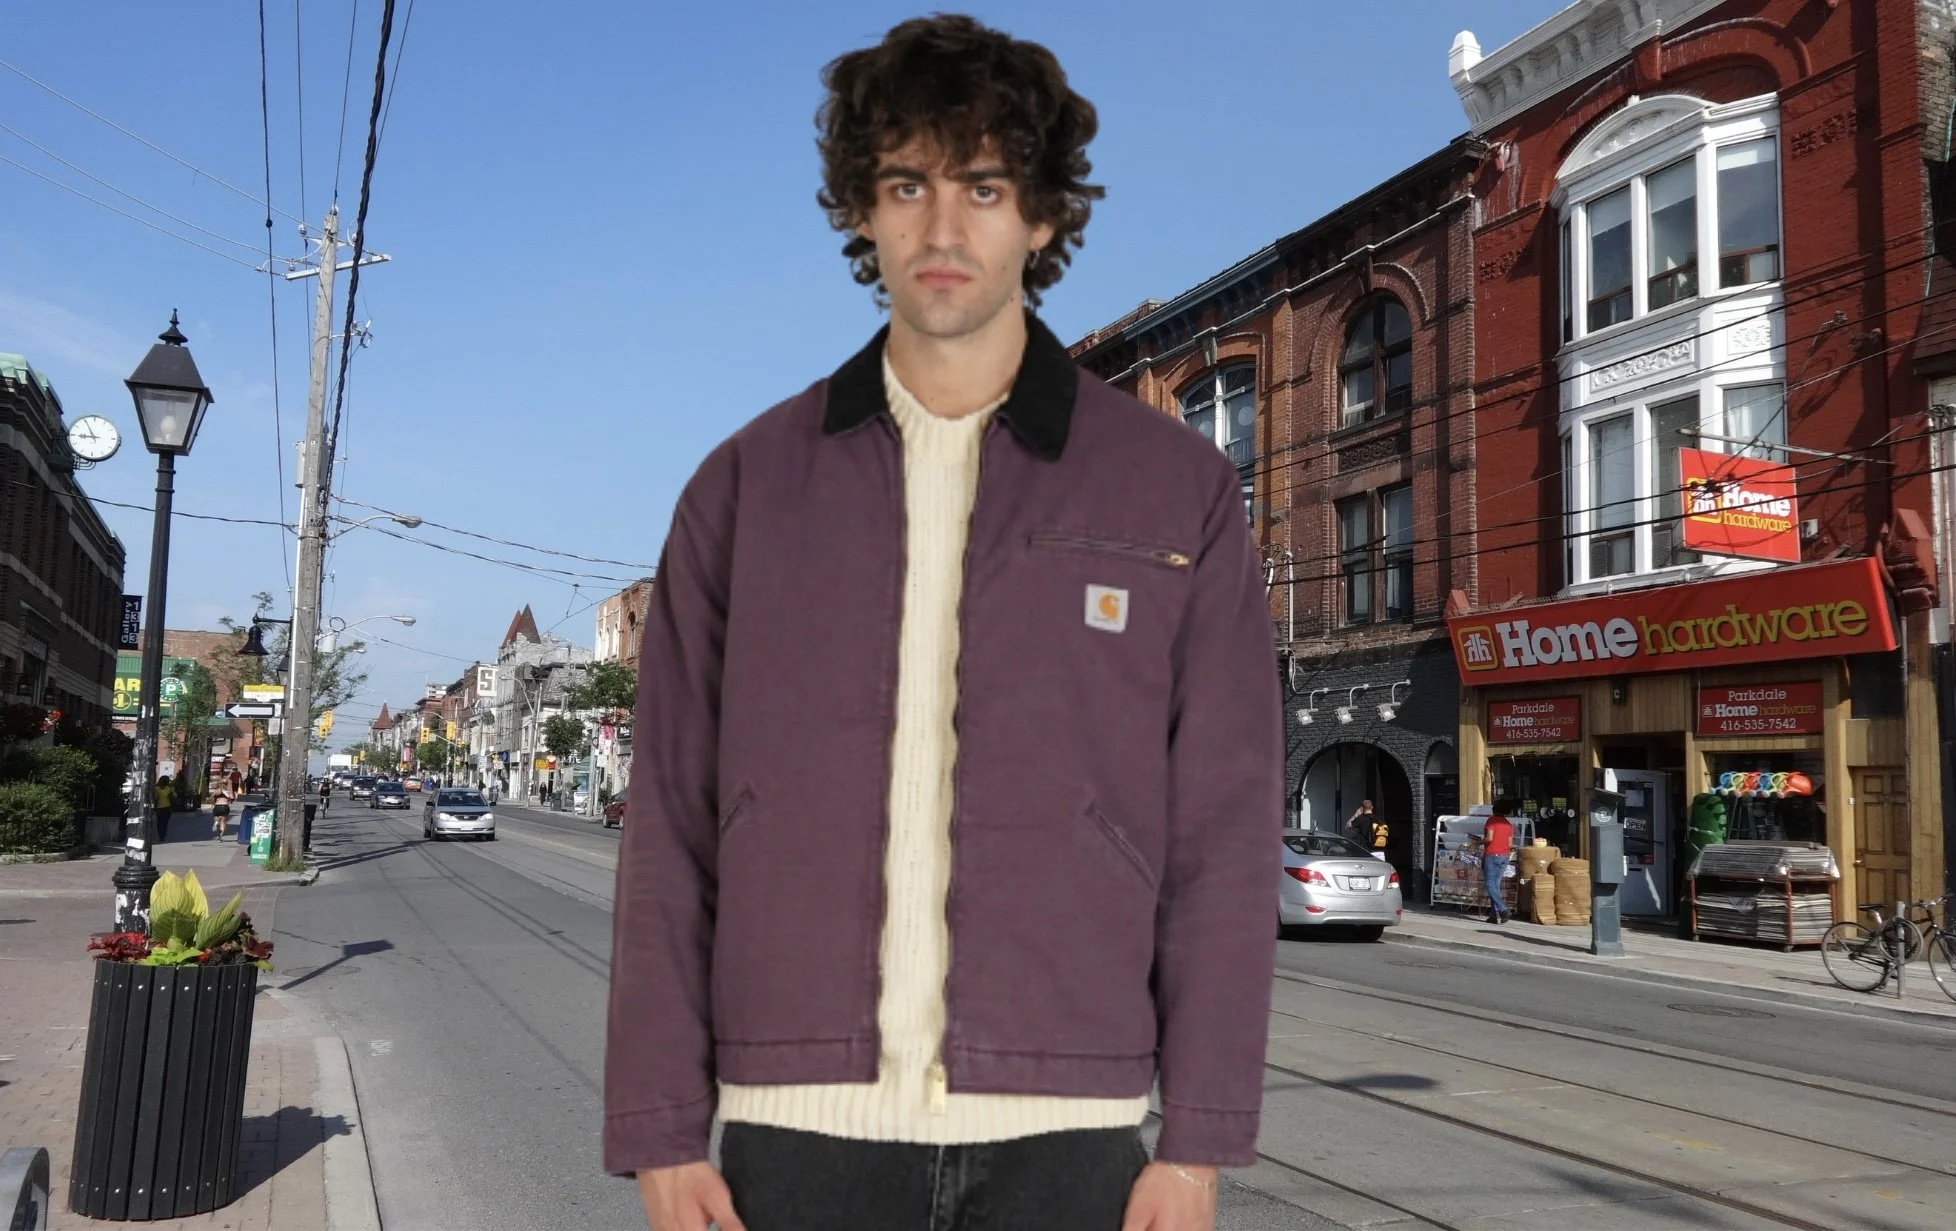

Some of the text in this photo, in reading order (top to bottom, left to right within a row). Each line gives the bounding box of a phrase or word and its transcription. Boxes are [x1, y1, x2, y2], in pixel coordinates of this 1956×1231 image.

[1722, 482, 1791, 517] Home
[1723, 511, 1792, 533] hardware
[121, 601, 132, 643] Gallery
[1495, 600, 1867, 669] Home hardware
[1728, 688, 1787, 701] Parkdale
[1512, 702, 1555, 715] Parkdale
[1715, 703, 1816, 717] Home hardware
[1502, 715, 1576, 728] Home hardware
[1720, 717, 1797, 731] 416-535-7542
[1506, 727, 1561, 739] 416-535-7542
[1626, 820, 1646, 830] OPEN
